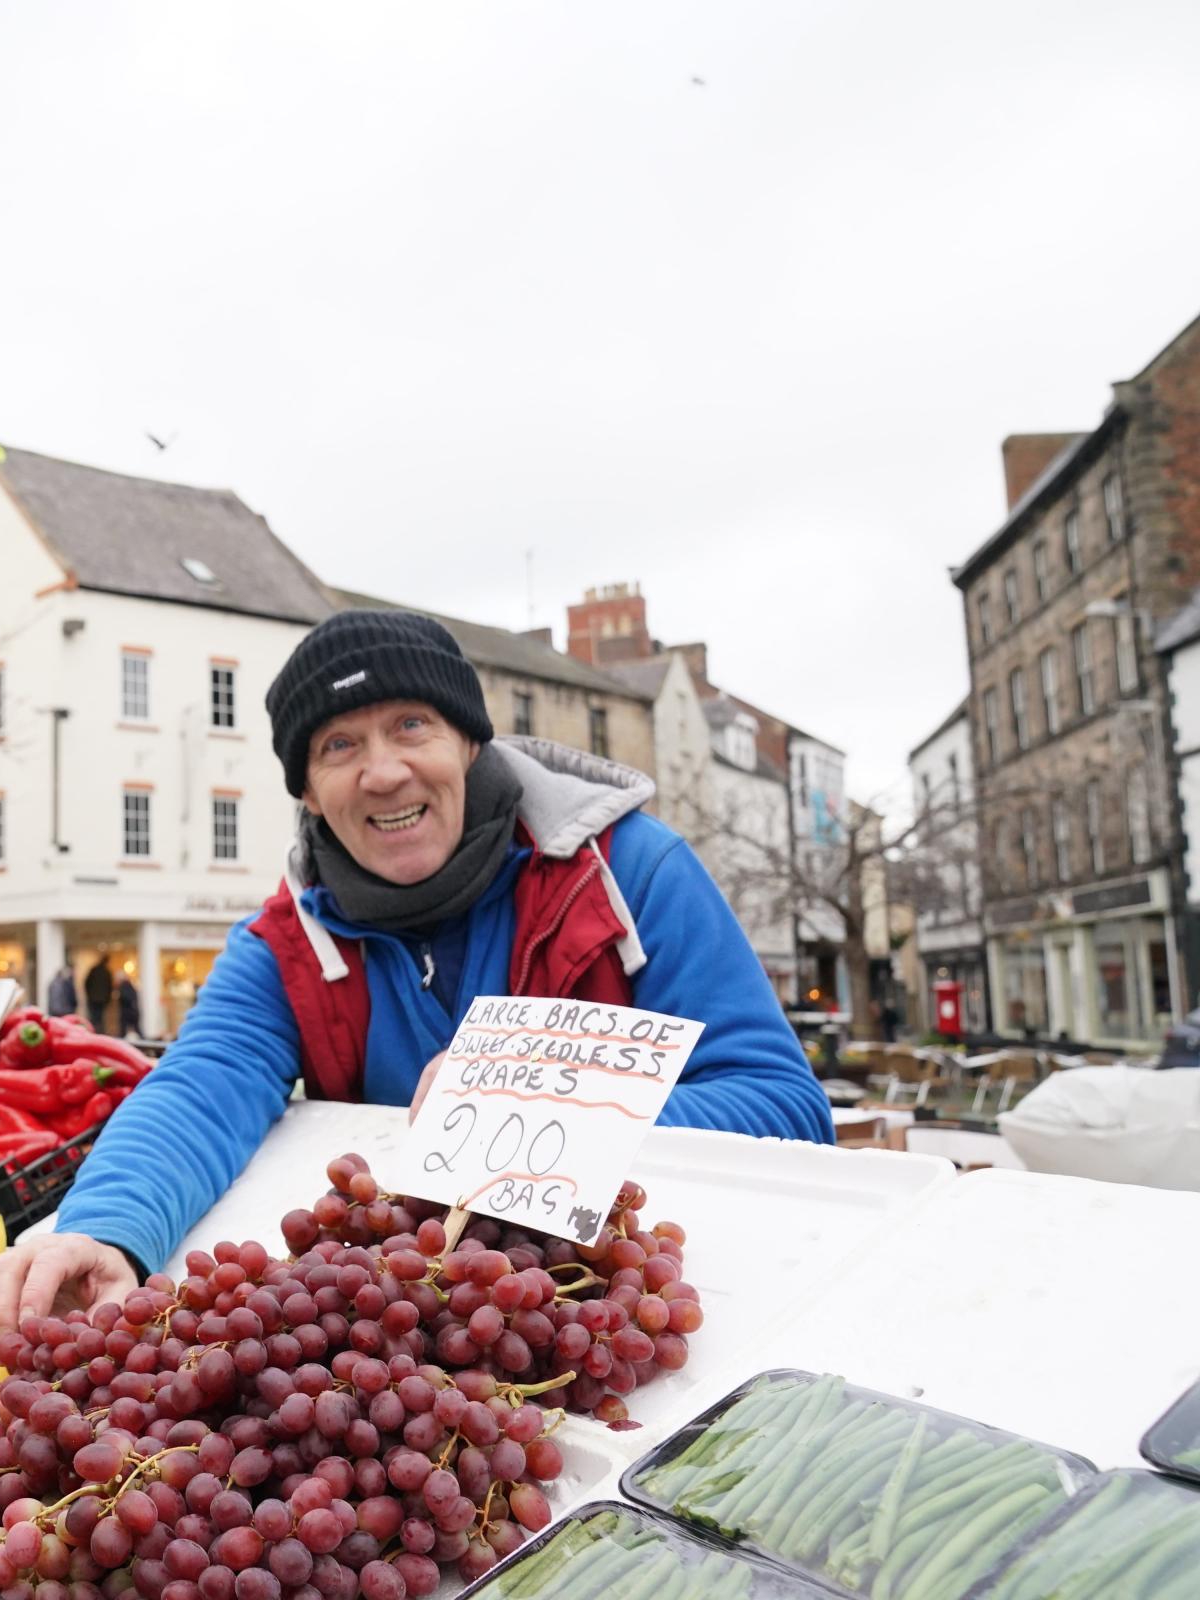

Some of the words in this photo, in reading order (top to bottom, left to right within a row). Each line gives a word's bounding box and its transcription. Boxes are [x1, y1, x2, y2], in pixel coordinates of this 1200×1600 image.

[464, 1001, 532, 1026] LARGE
[544, 1003, 618, 1036] BAGS
[629, 1019, 685, 1046] OF
[451, 1031, 517, 1056] SWEET
[460, 1060, 580, 1096] GRAPES
[488, 1177, 562, 1216] BAG
